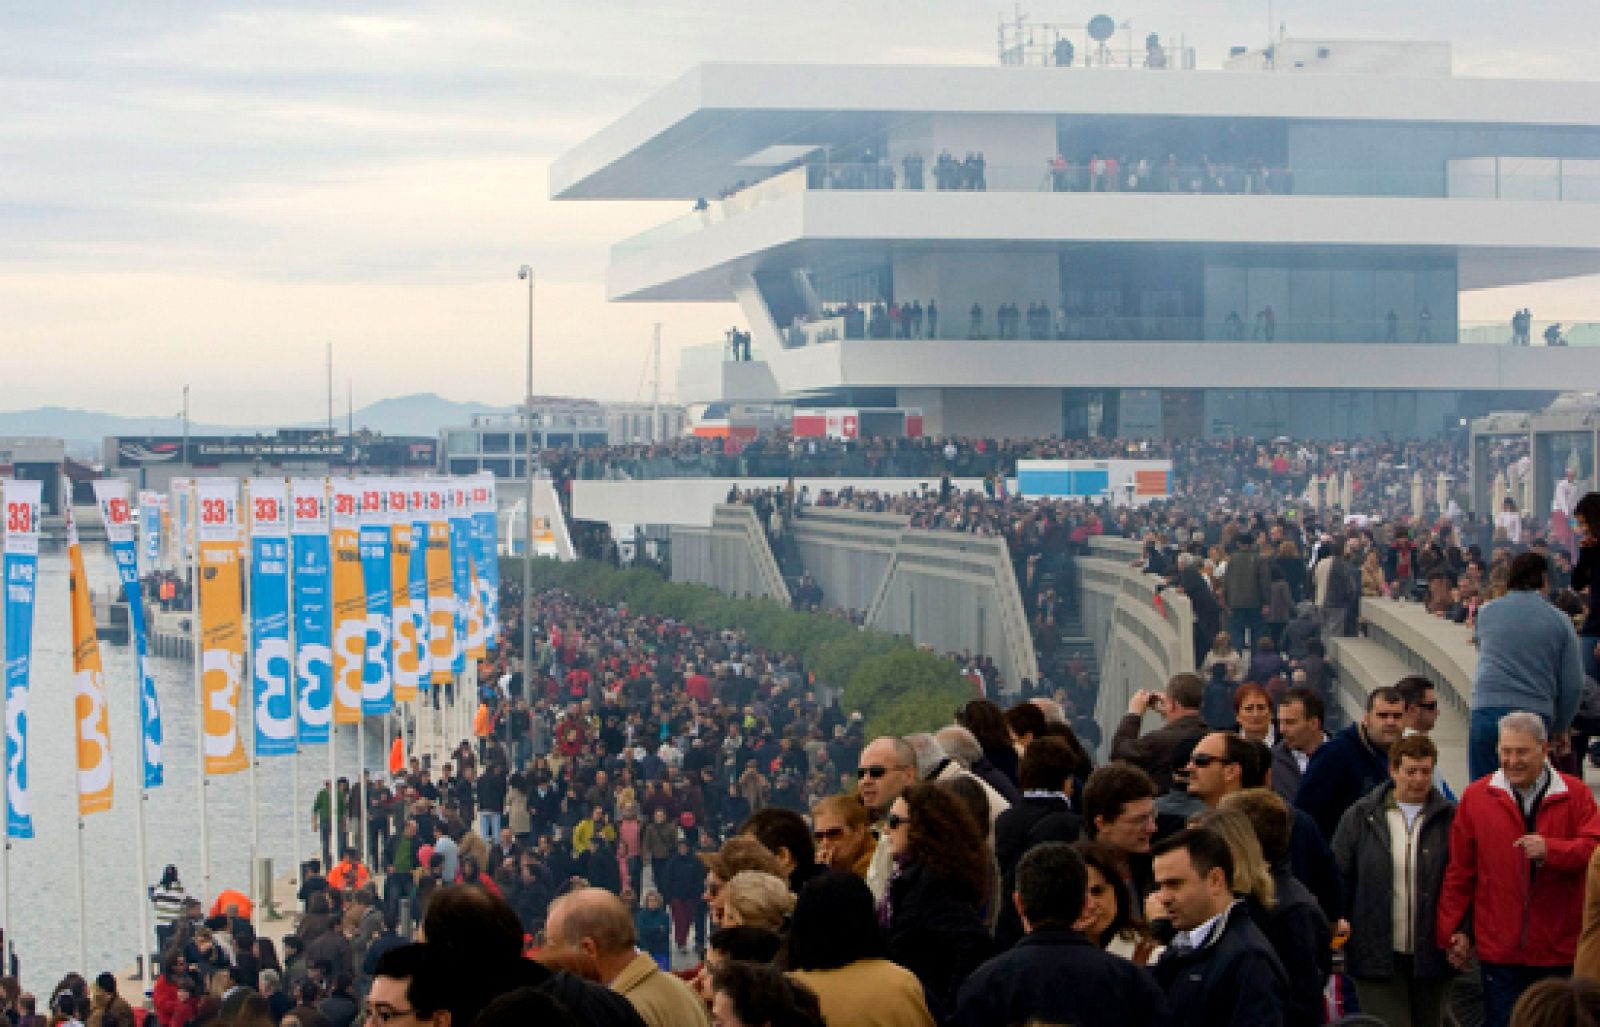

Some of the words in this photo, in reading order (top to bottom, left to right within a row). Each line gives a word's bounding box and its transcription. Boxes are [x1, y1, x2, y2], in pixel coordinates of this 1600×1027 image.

[7, 501, 31, 532] 33
[202, 498, 225, 523] 33
[255, 497, 277, 521] 33
[295, 496, 318, 518] 33
